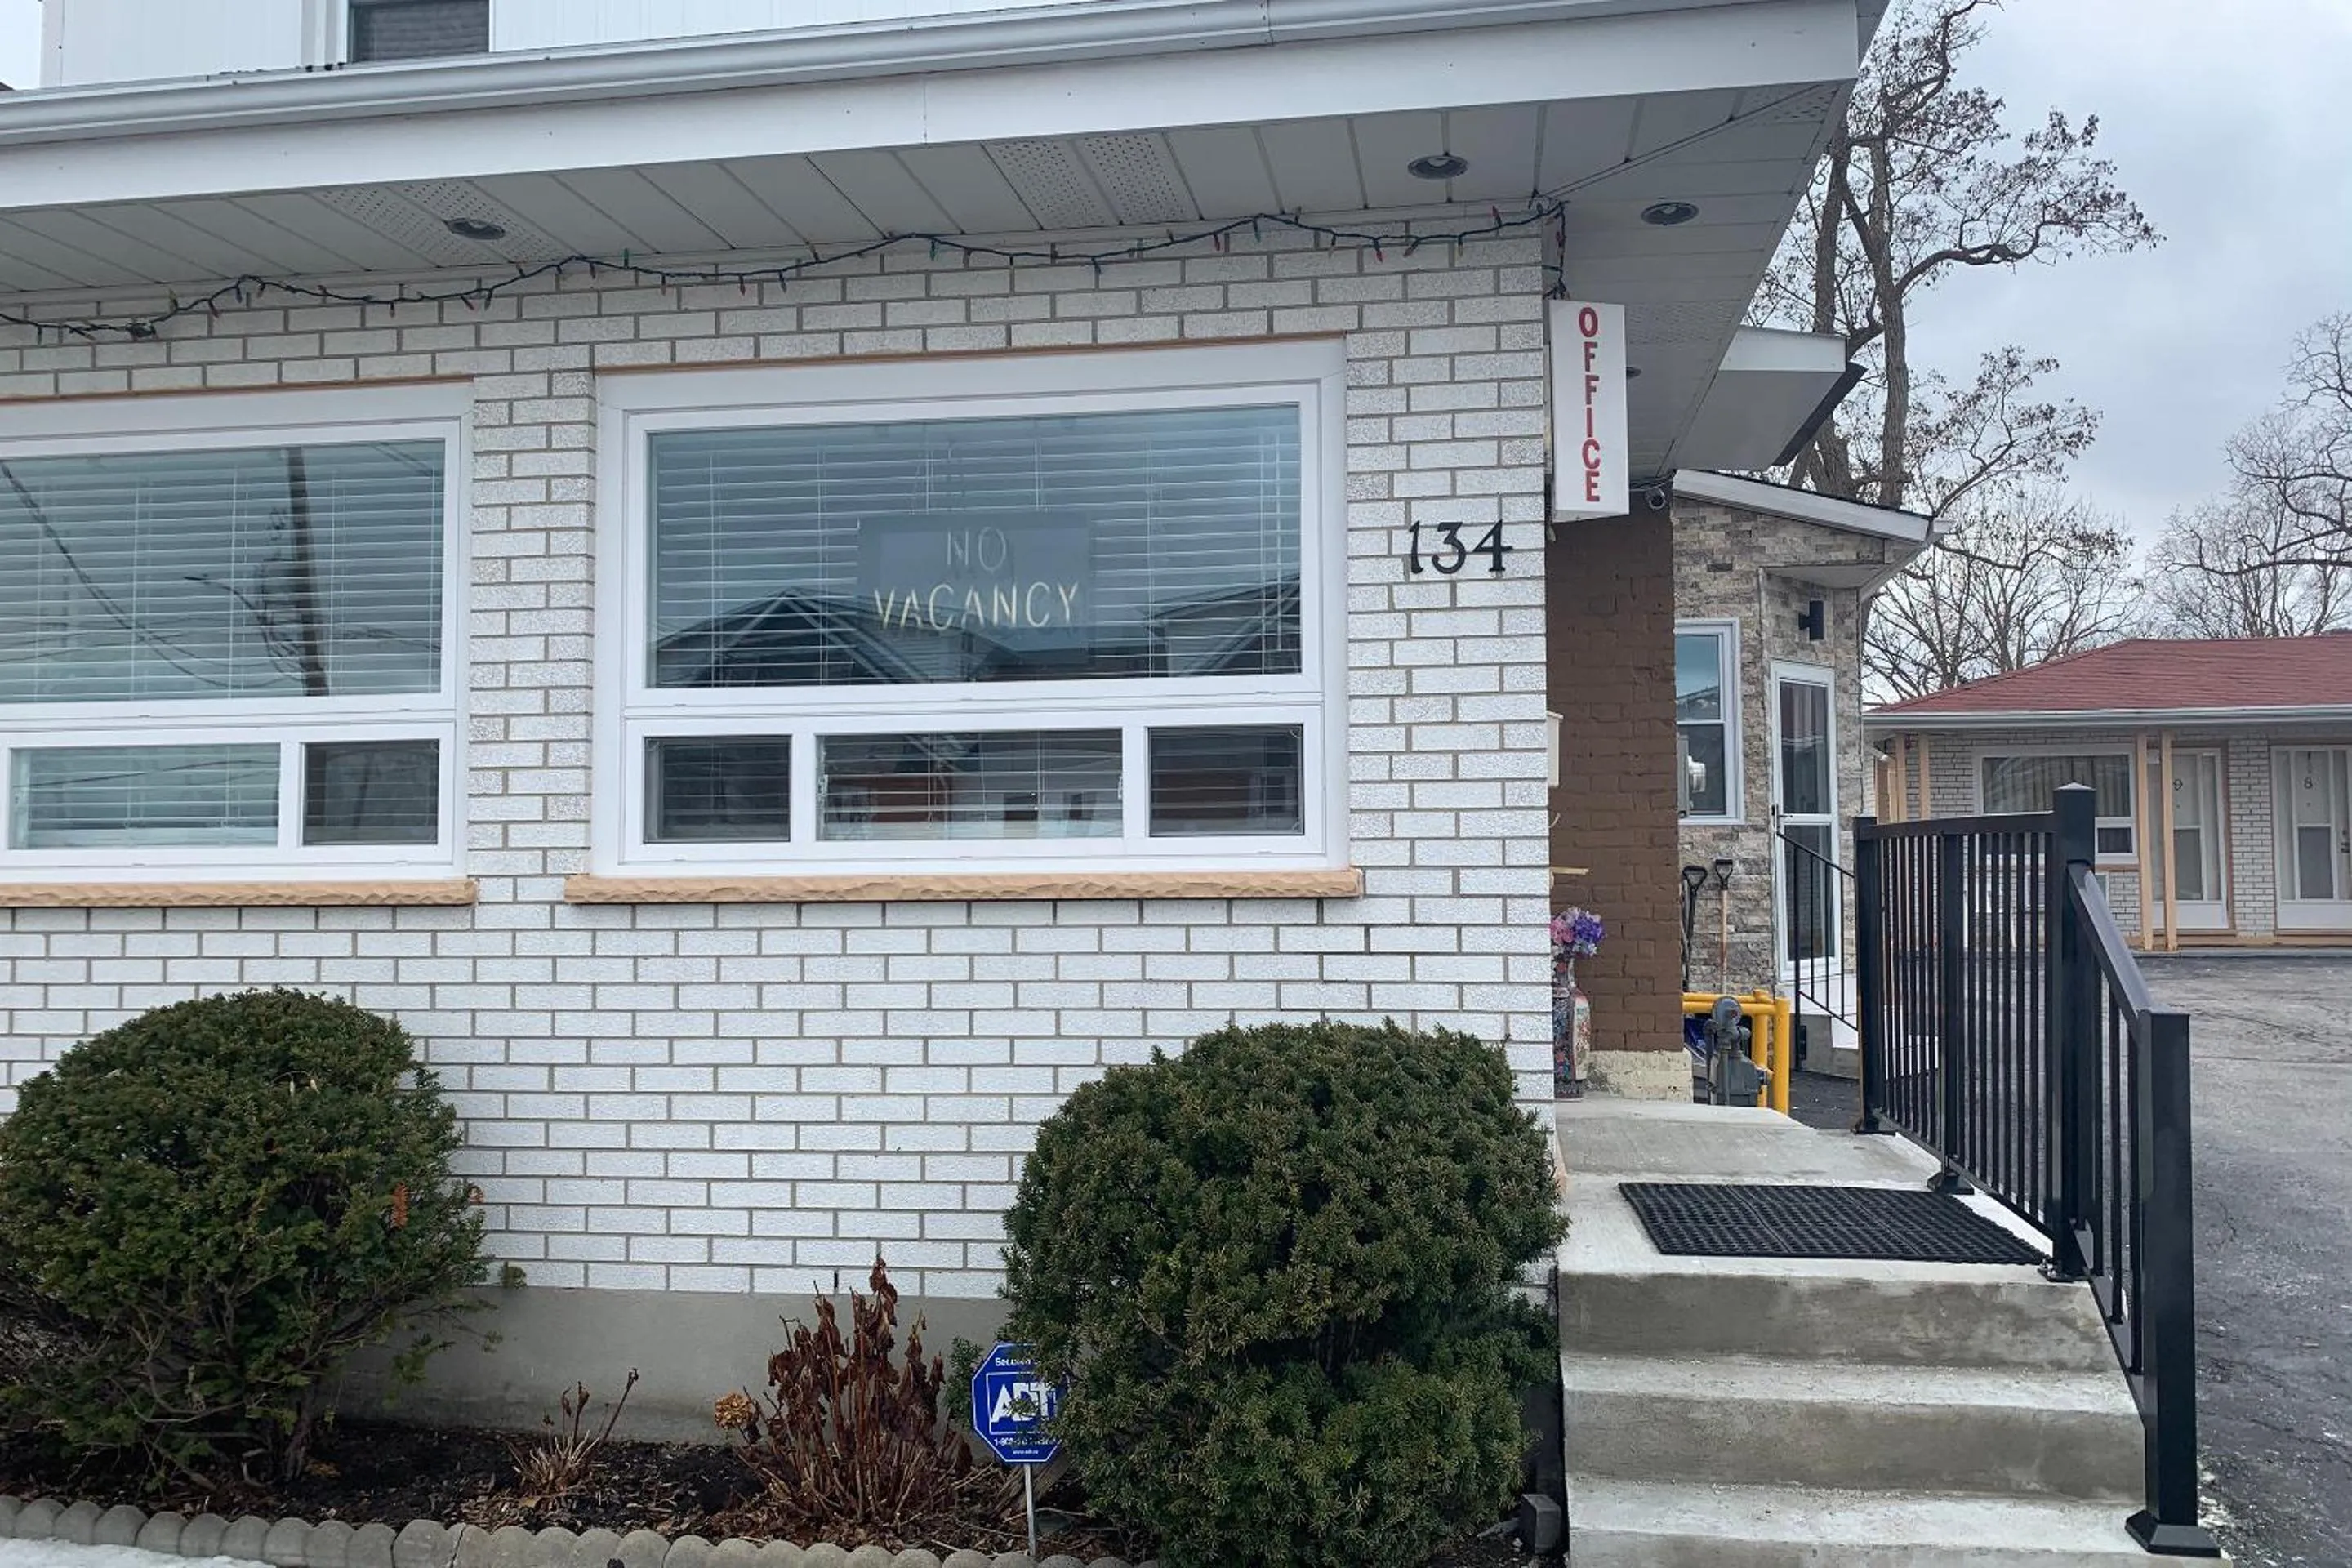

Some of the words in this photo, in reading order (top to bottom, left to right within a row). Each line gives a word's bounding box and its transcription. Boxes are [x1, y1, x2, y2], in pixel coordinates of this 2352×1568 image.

[1578, 306, 1601, 502] OFFICE
[946, 526, 1007, 572] NO
[1408, 519, 1513, 574] 134
[873, 581, 1079, 630] VACANCY
[990, 1382, 1056, 1423] ADT
